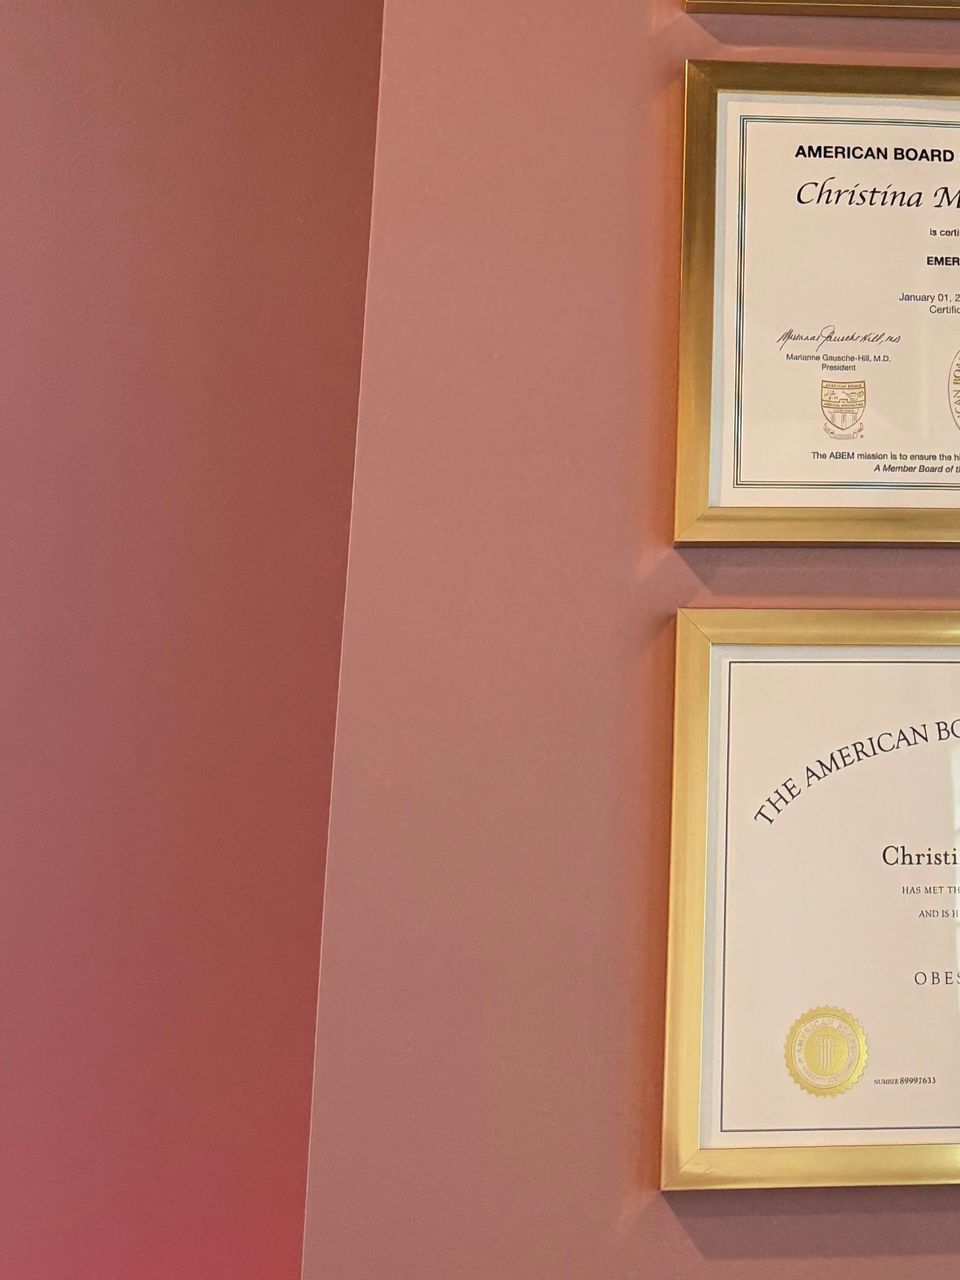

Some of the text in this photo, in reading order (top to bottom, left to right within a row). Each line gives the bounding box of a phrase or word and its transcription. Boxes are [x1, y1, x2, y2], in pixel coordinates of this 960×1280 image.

[794, 145, 888, 161] AMERICAN
[893, 147, 955, 163] BOARD
[796, 176, 923, 208] Christina
[929, 228, 938, 237] is
[899, 293, 936, 304] January
[938, 293, 952, 304] 01,
[785, 353, 821, 362] Marianne
[873, 355, 891, 363] M.D.
[821, 363, 856, 371] President
[811, 451, 827, 460] The
[829, 452, 855, 460] ABEM
[856, 452, 888, 461] mission
[890, 452, 898, 461] is
[899, 453, 908, 461] to
[910, 453, 937, 462] ensure
[939, 453, 952, 462] the
[753, 777, 802, 826] THE
[804, 723, 930, 788] AMERICAN
[902, 885, 921, 895] HAS
[924, 885, 944, 895] MET
